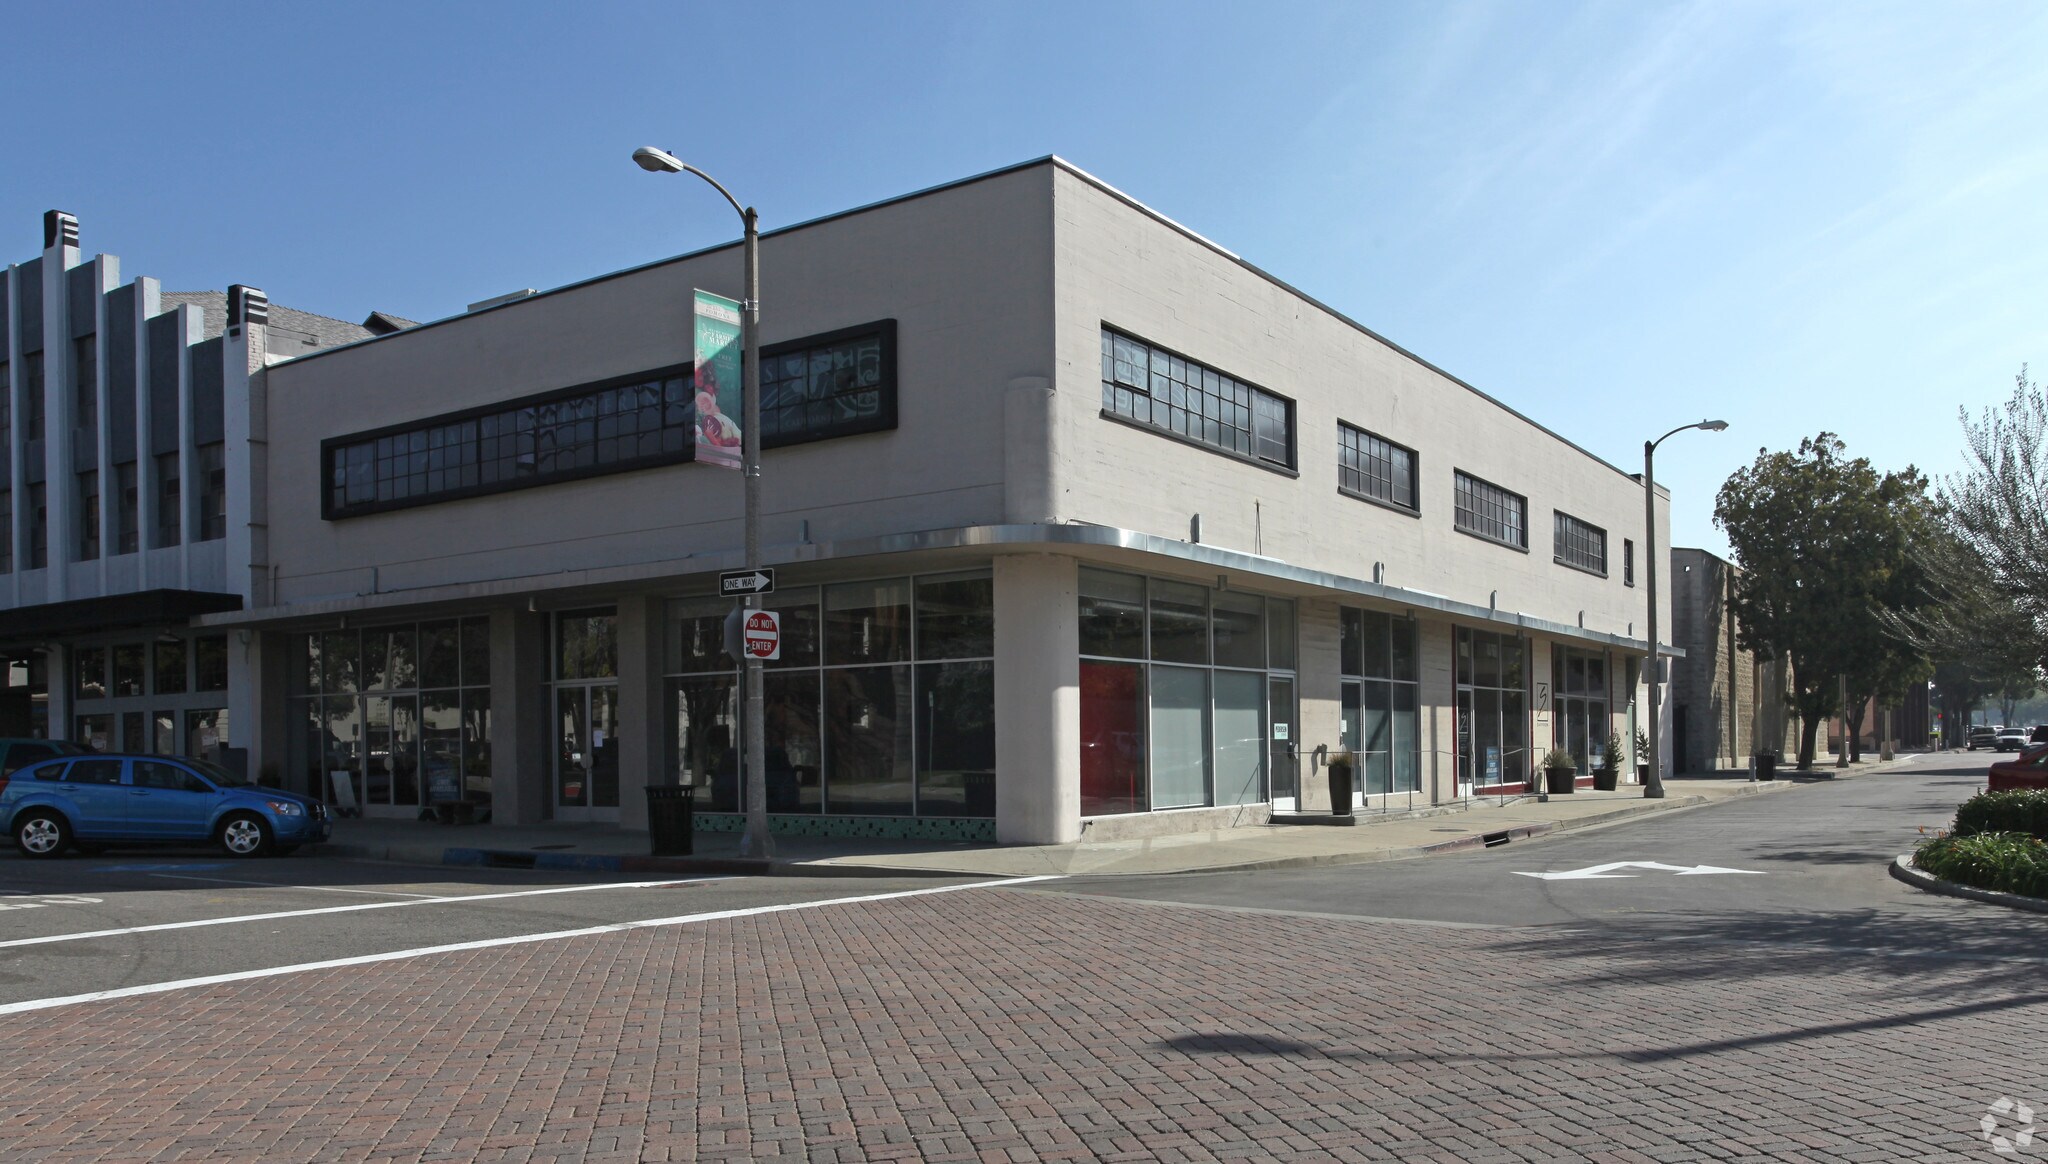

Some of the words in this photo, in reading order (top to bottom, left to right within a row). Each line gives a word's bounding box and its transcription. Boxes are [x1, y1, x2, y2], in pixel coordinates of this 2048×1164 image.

[724, 579, 739, 589] ONE
[742, 577, 756, 587] WAY
[749, 618, 758, 627] DO
[761, 620, 773, 629] NOT
[751, 641, 772, 651] ENTER
